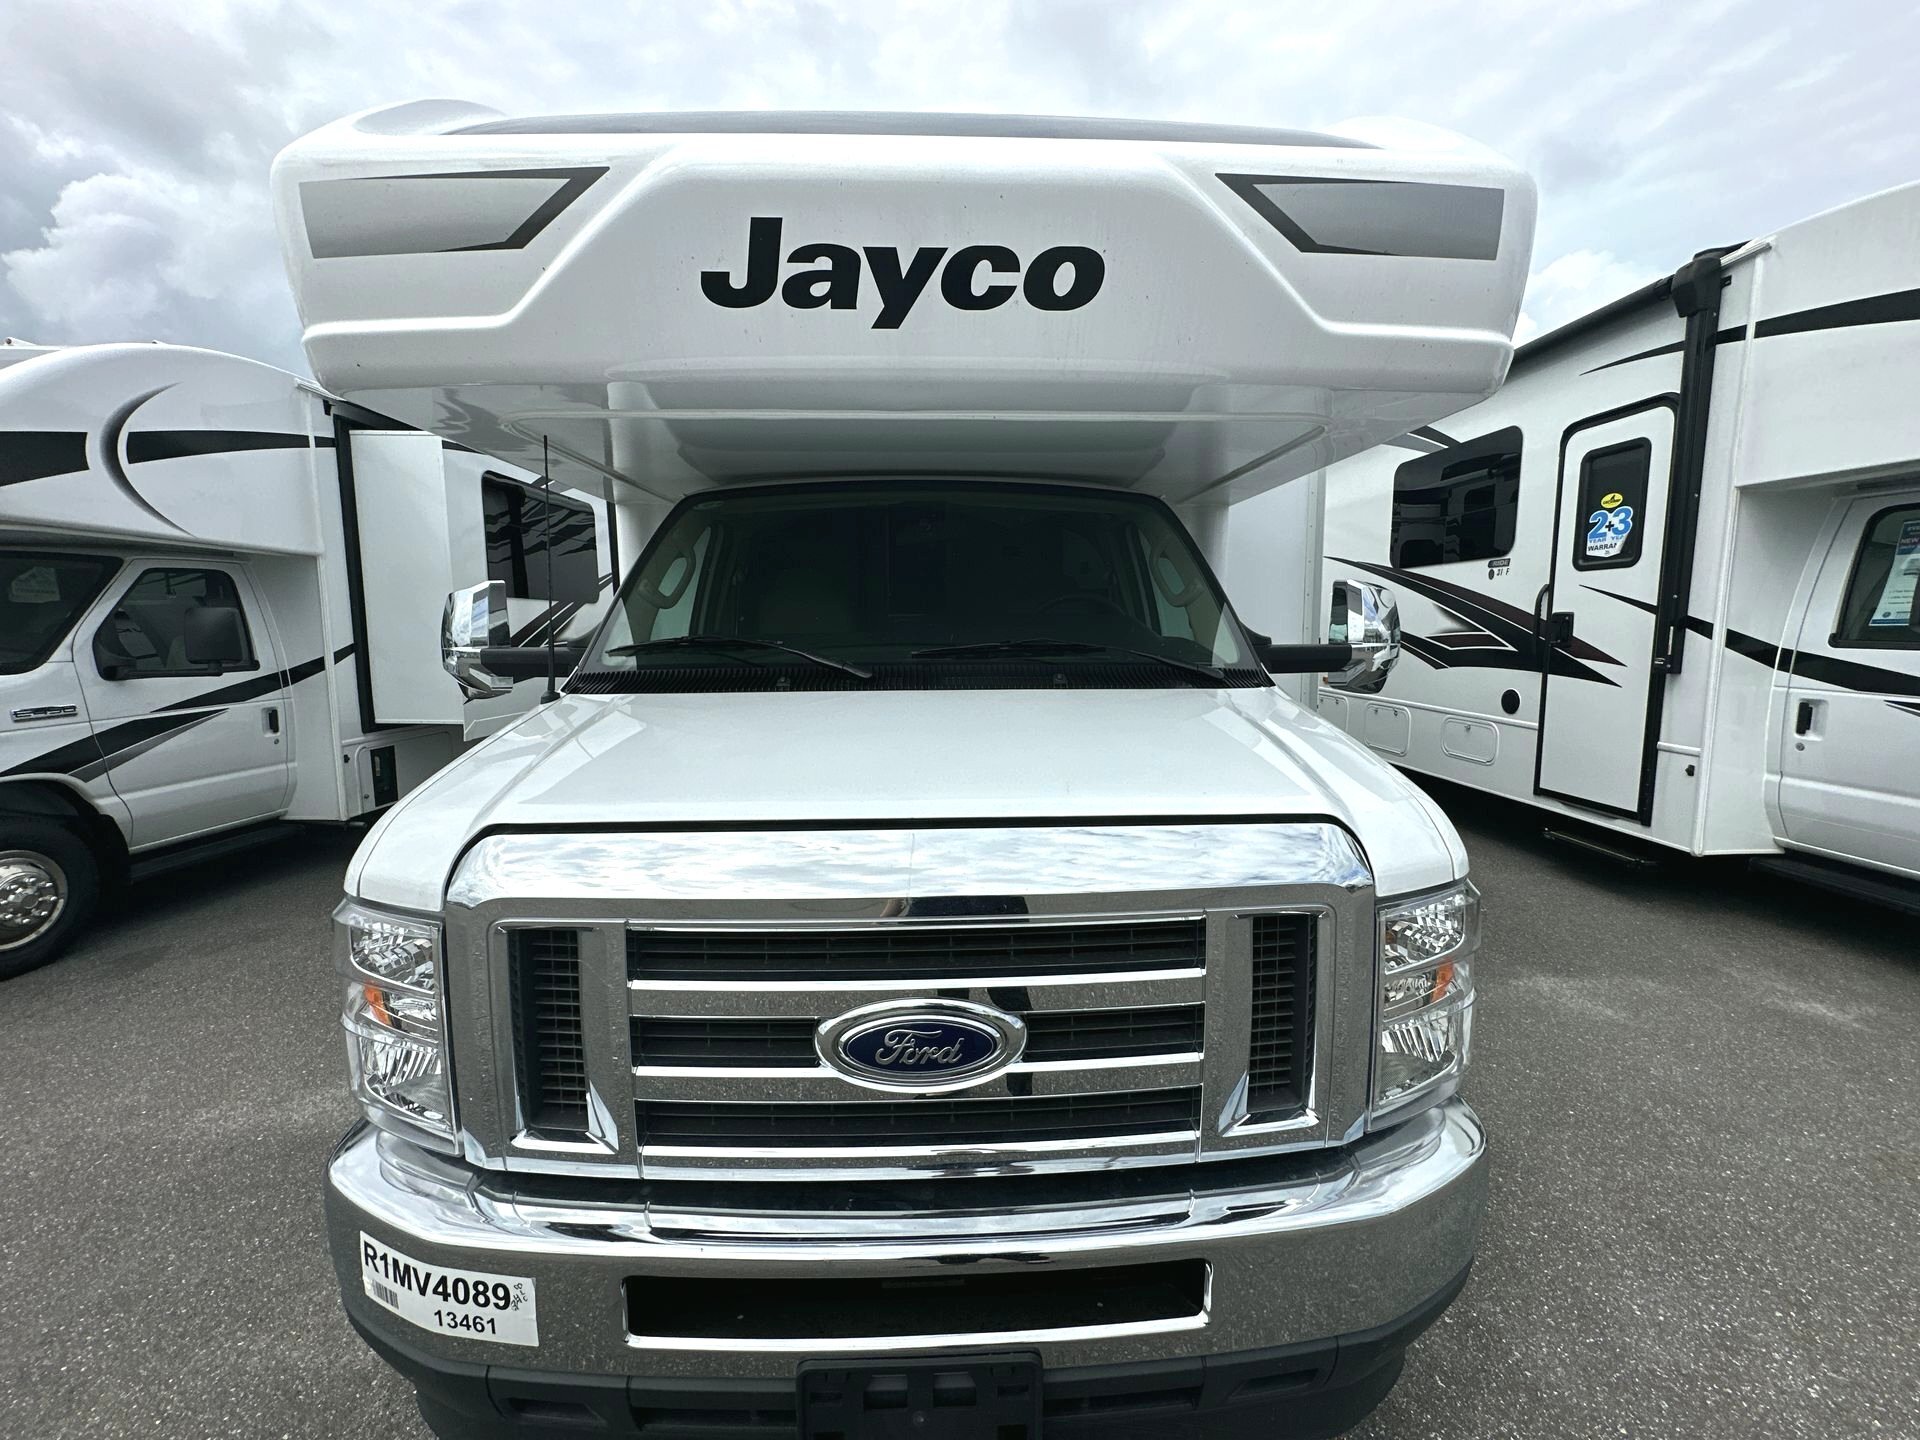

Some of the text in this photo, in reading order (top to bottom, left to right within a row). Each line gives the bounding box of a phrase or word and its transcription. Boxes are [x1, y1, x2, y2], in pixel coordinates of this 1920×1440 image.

[700, 216, 1106, 330] Jayco
[875, 1029, 965, 1065] Ford
[363, 1240, 512, 1311] R1MV4089
[434, 1309, 497, 1335] 13461
